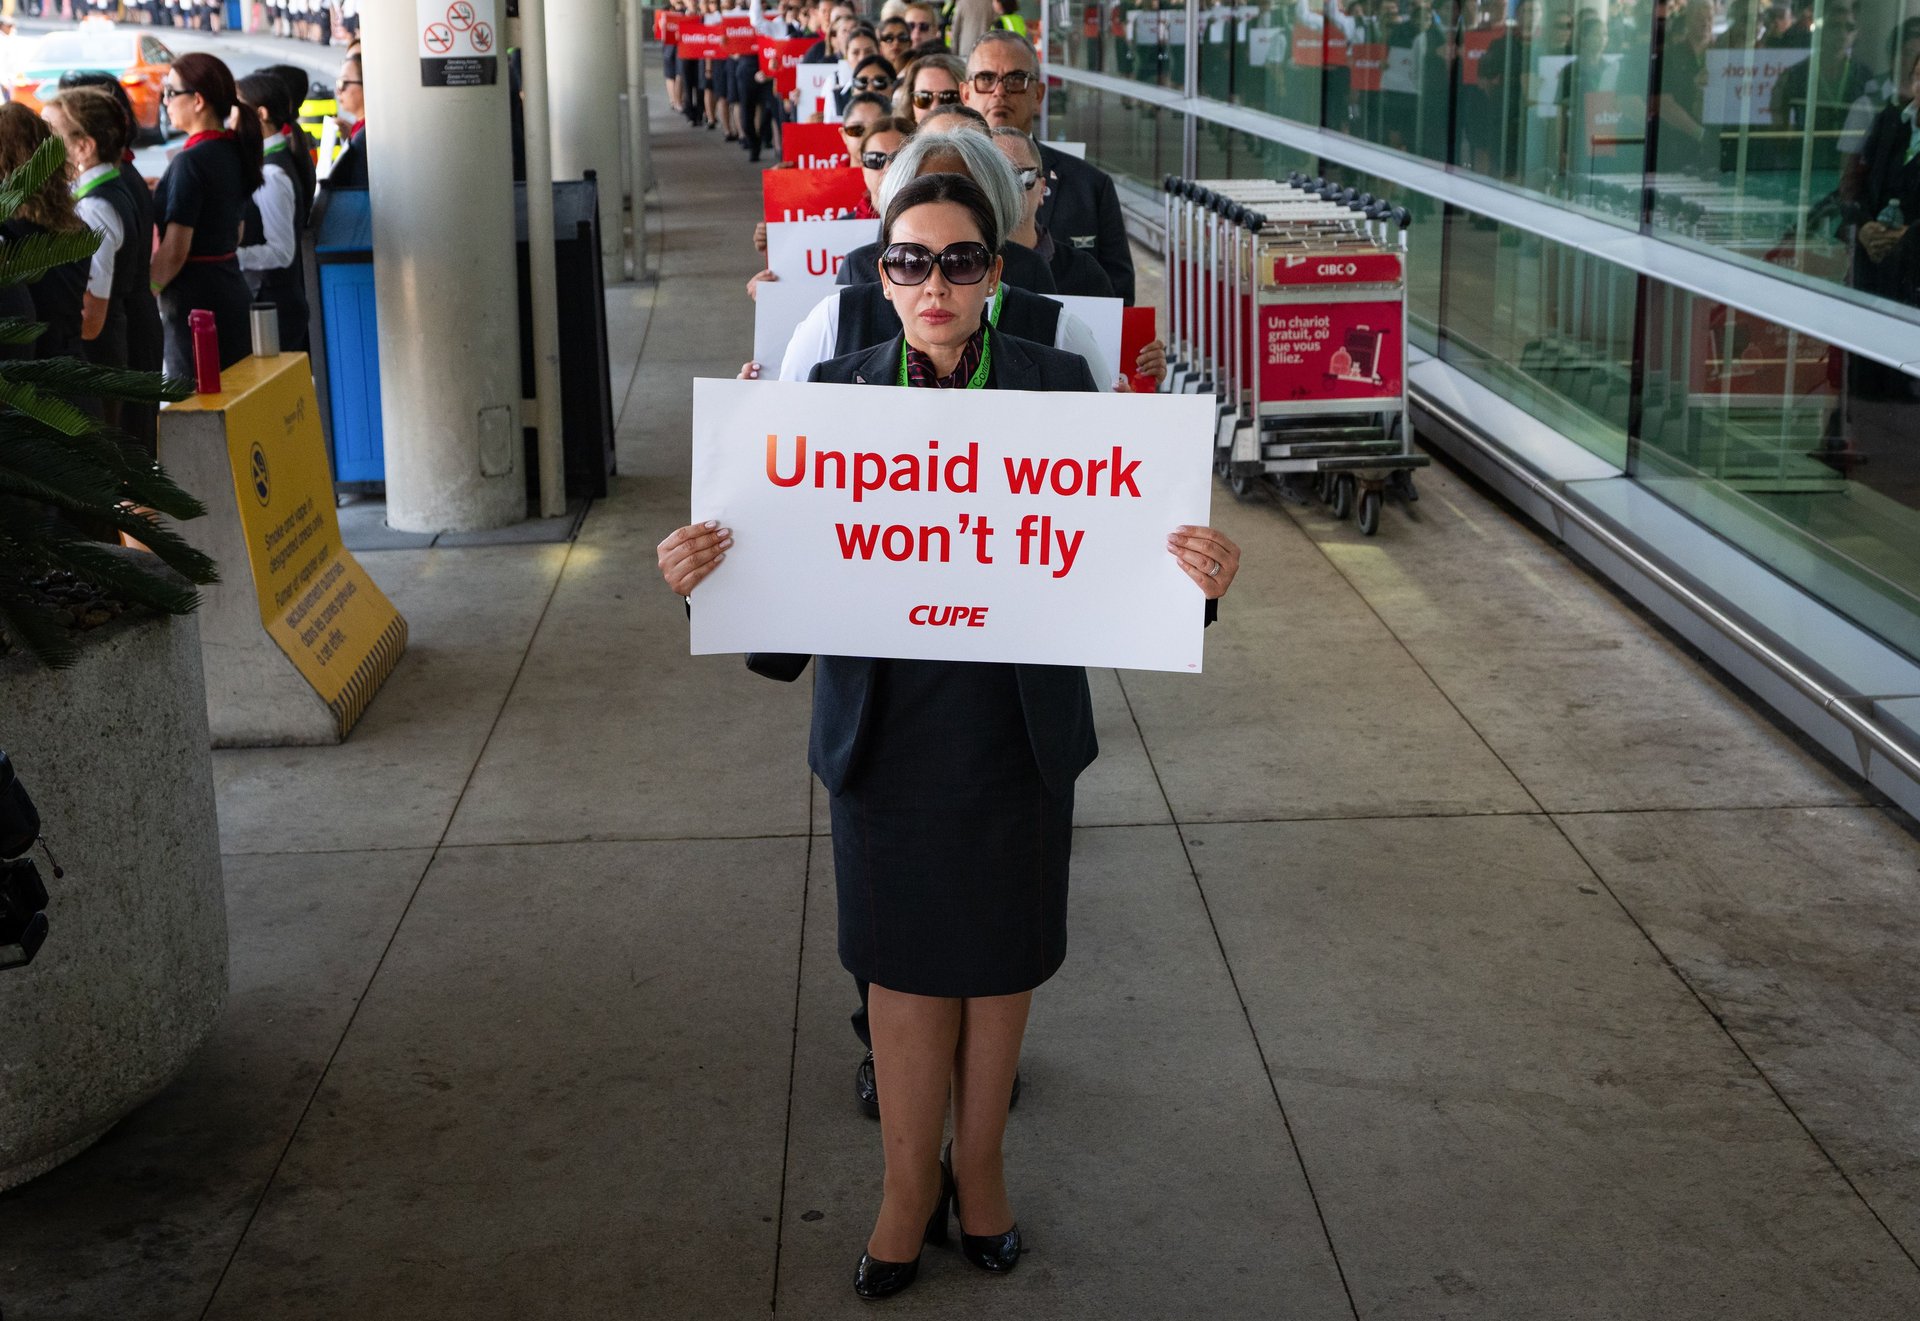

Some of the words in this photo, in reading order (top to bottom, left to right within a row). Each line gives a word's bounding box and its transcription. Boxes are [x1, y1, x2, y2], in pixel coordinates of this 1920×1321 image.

[1317, 264, 1345, 276] CIBC
[1268, 316, 1286, 329] Un
[1288, 315, 1330, 328] chariot
[1268, 329, 1312, 343] gratuit,
[1314, 326, 1330, 339] où
[1268, 342, 1291, 353] que
[1293, 341, 1321, 351] vous
[1268, 352, 1304, 365] alliez.
[765, 434, 979, 503] Unpaid
[1003, 446, 1143, 498] work
[265, 524, 284, 552] Smoke
[284, 512, 295, 534] and
[269, 532, 299, 575] designated
[1016, 514, 1085, 579] fly
[908, 605, 989, 628] CUPE
